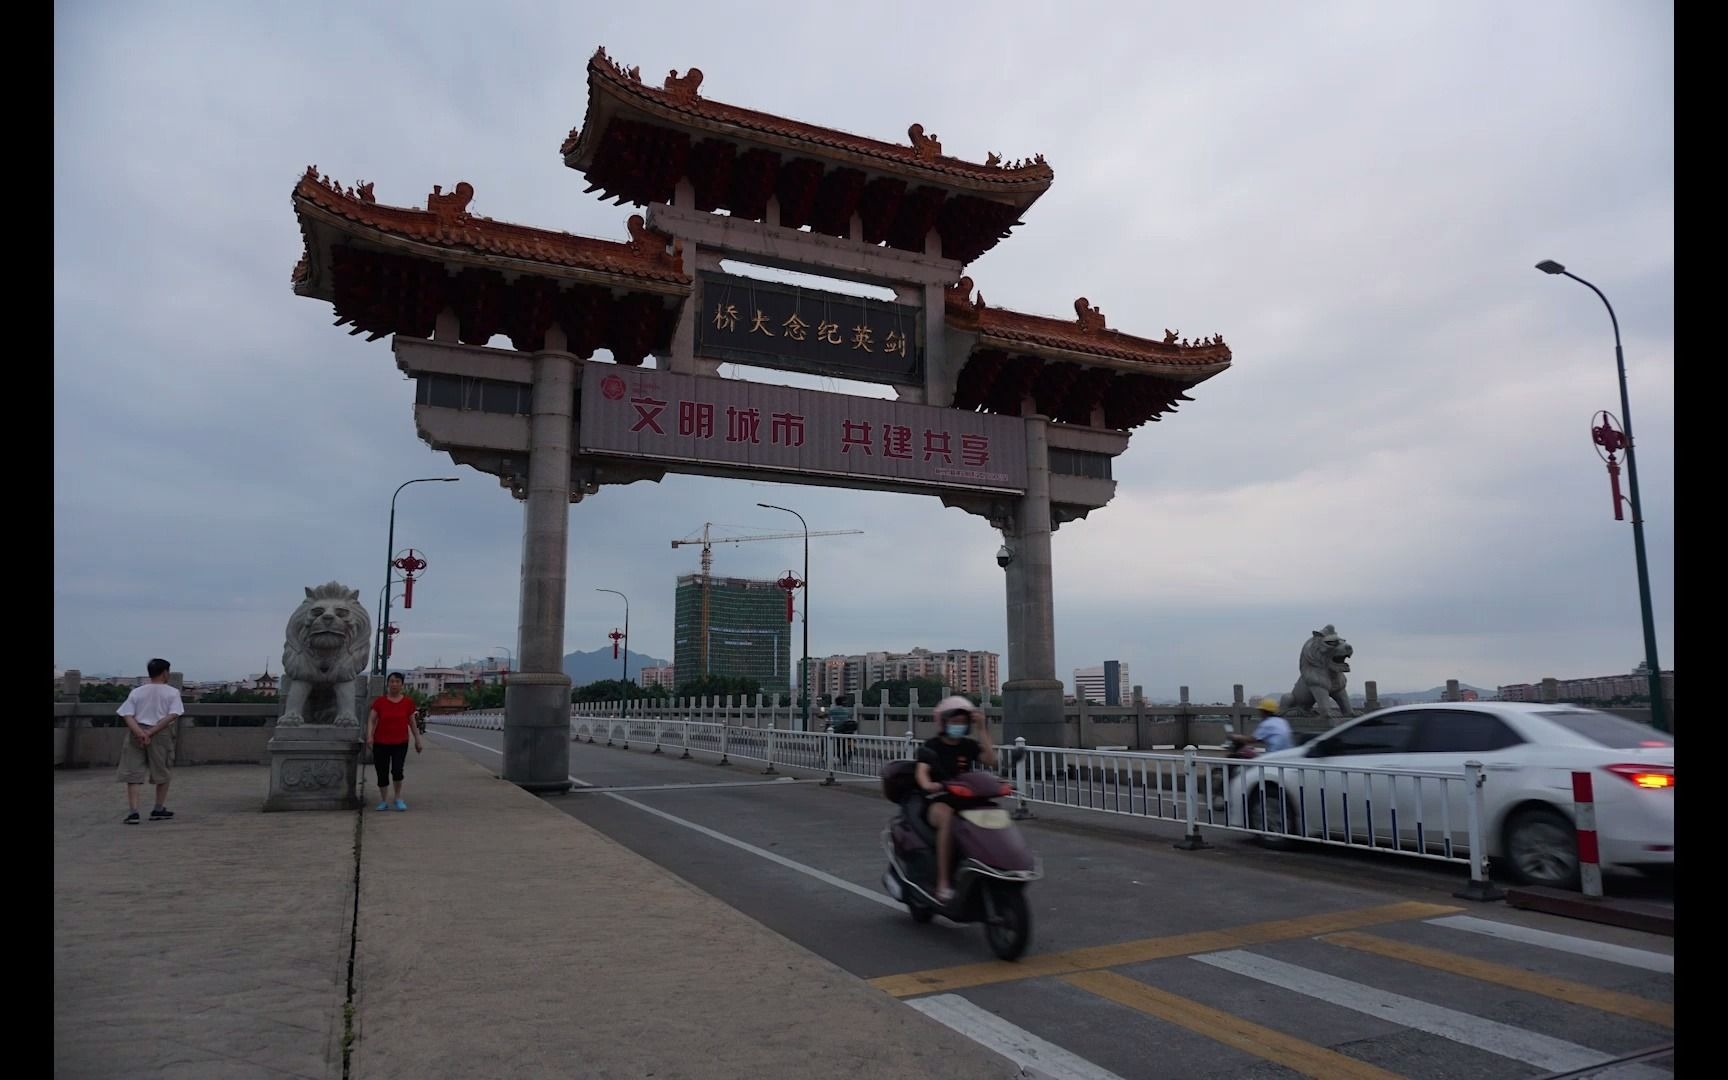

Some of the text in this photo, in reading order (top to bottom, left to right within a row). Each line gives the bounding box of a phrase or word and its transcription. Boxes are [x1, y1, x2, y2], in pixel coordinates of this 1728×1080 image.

[629, 396, 991, 467] 文明城市 共建共享
